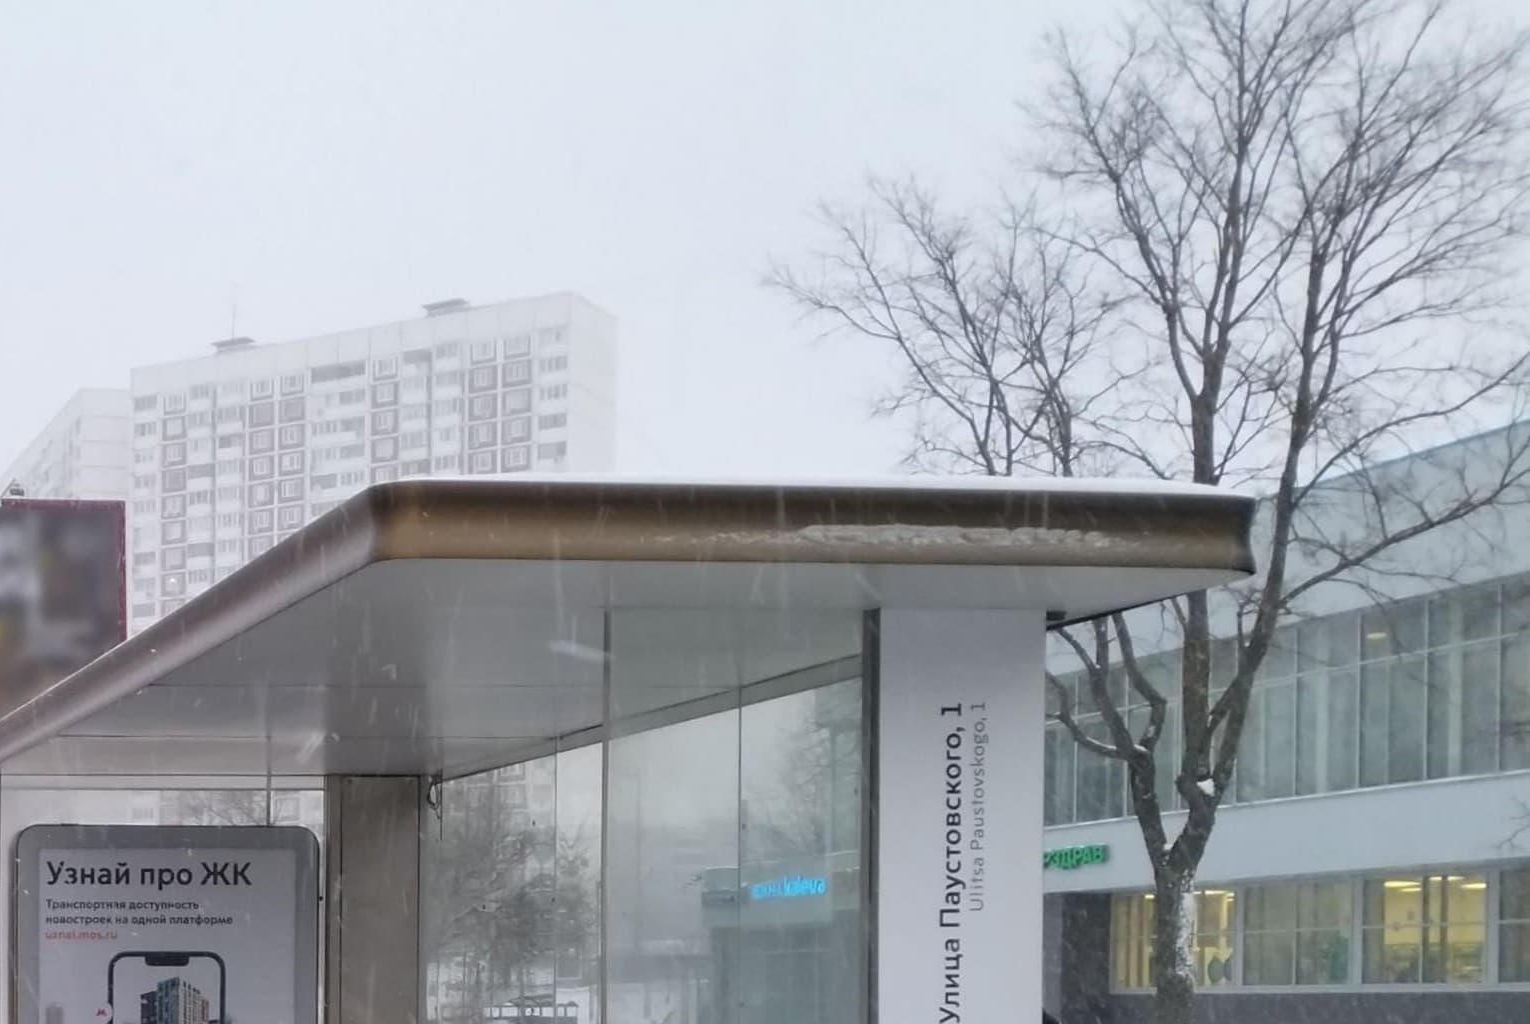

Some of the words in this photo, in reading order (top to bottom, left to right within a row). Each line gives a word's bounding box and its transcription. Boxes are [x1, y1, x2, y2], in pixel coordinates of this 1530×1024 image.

[941, 703, 962, 716] 1
[971, 703, 986, 711] 1
[969, 717, 989, 851] Paustovskogo,
[939, 727, 966, 928] Паустовского,
[46, 861, 130, 886] Узнай
[140, 867, 193, 891] про
[200, 861, 253, 886] ЖК
[969, 857, 985, 912] Ulitsa
[45, 899, 126, 911] Транспортная
[128, 901, 200, 911] доступность
[45, 916, 113, 926] новостроек
[115, 916, 129, 925] на
[131, 914, 167, 926] одной
[169, 915, 234, 926] платформе
[939, 938, 963, 1024] Улица
